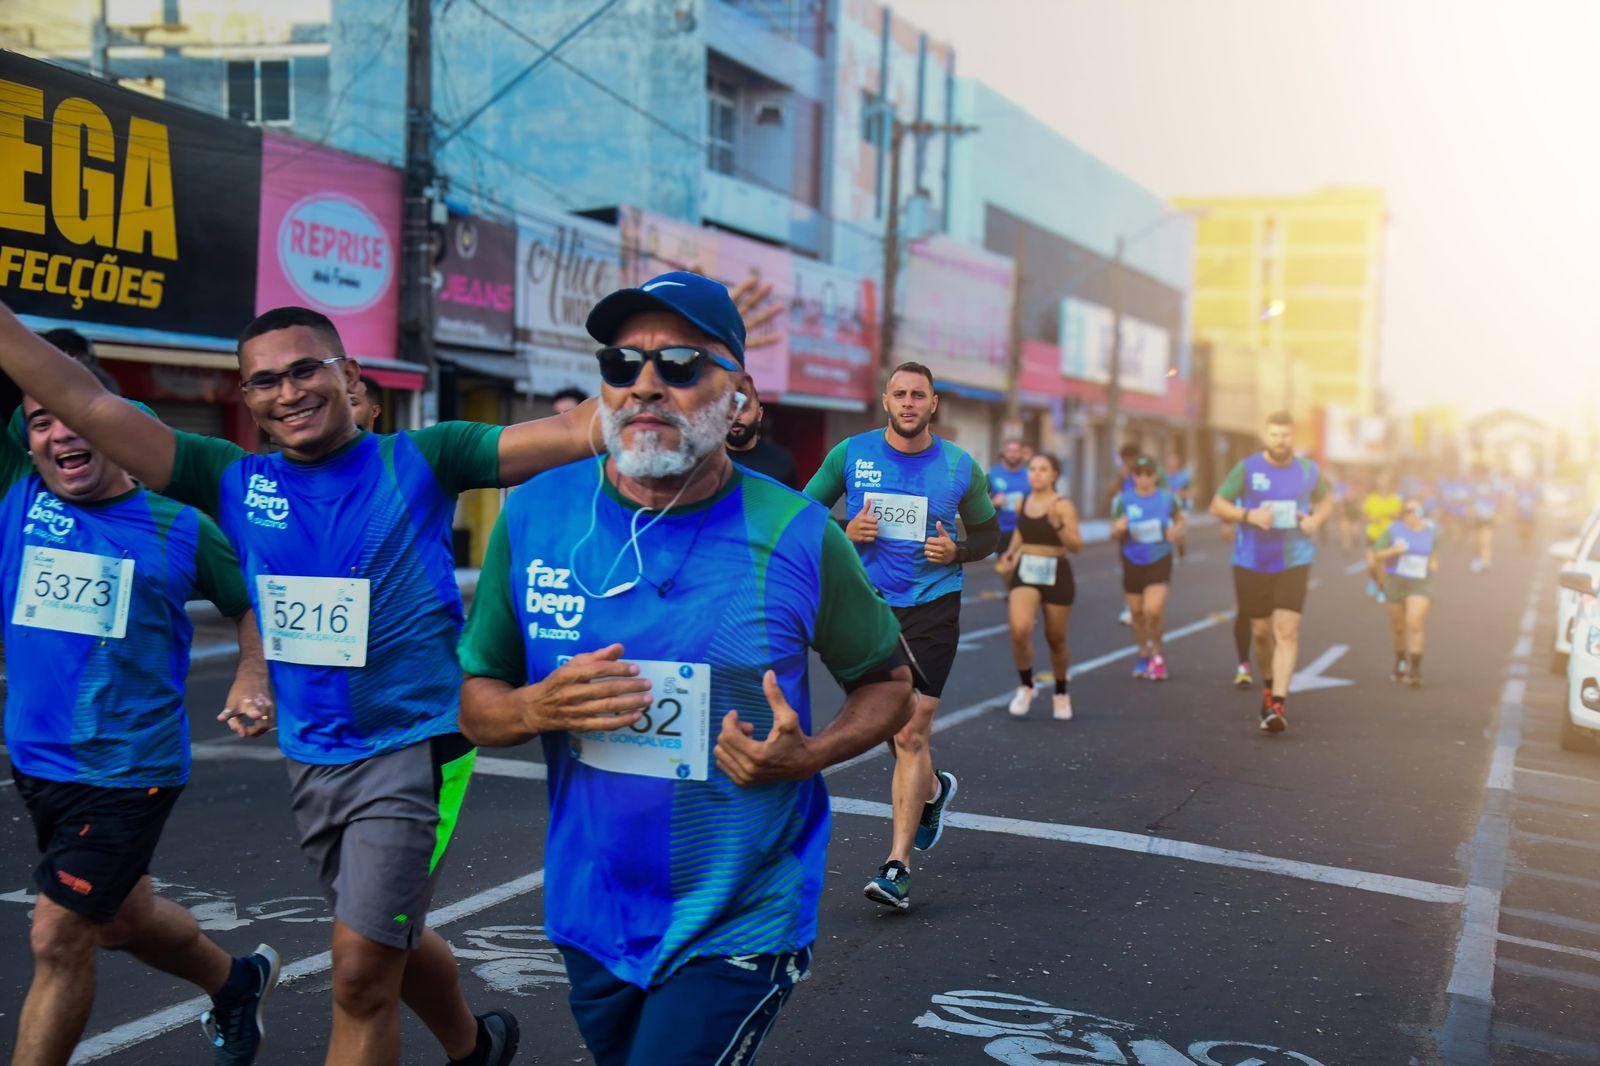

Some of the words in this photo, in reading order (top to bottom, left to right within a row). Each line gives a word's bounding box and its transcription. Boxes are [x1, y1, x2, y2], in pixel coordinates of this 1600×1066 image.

[0, 78, 178, 260] EGA
[289, 219, 384, 269] REPRISE
[0, 246, 165, 310] FECÇÕES
[439, 274, 513, 312] JEANS
[855, 459, 874, 469] faz
[855, 470, 882, 479] bem
[249, 474, 277, 493] faz
[244, 490, 289, 510] bem
[27, 503, 74, 529] bem
[873, 506, 917, 525] 5526
[527, 559, 571, 589] faz
[34, 571, 112, 607] 5373
[526, 588, 585, 614] bem
[274, 600, 349, 633] 5216
[538, 628, 580, 641] suzano
[609, 733, 682, 749] GONÇALVES
